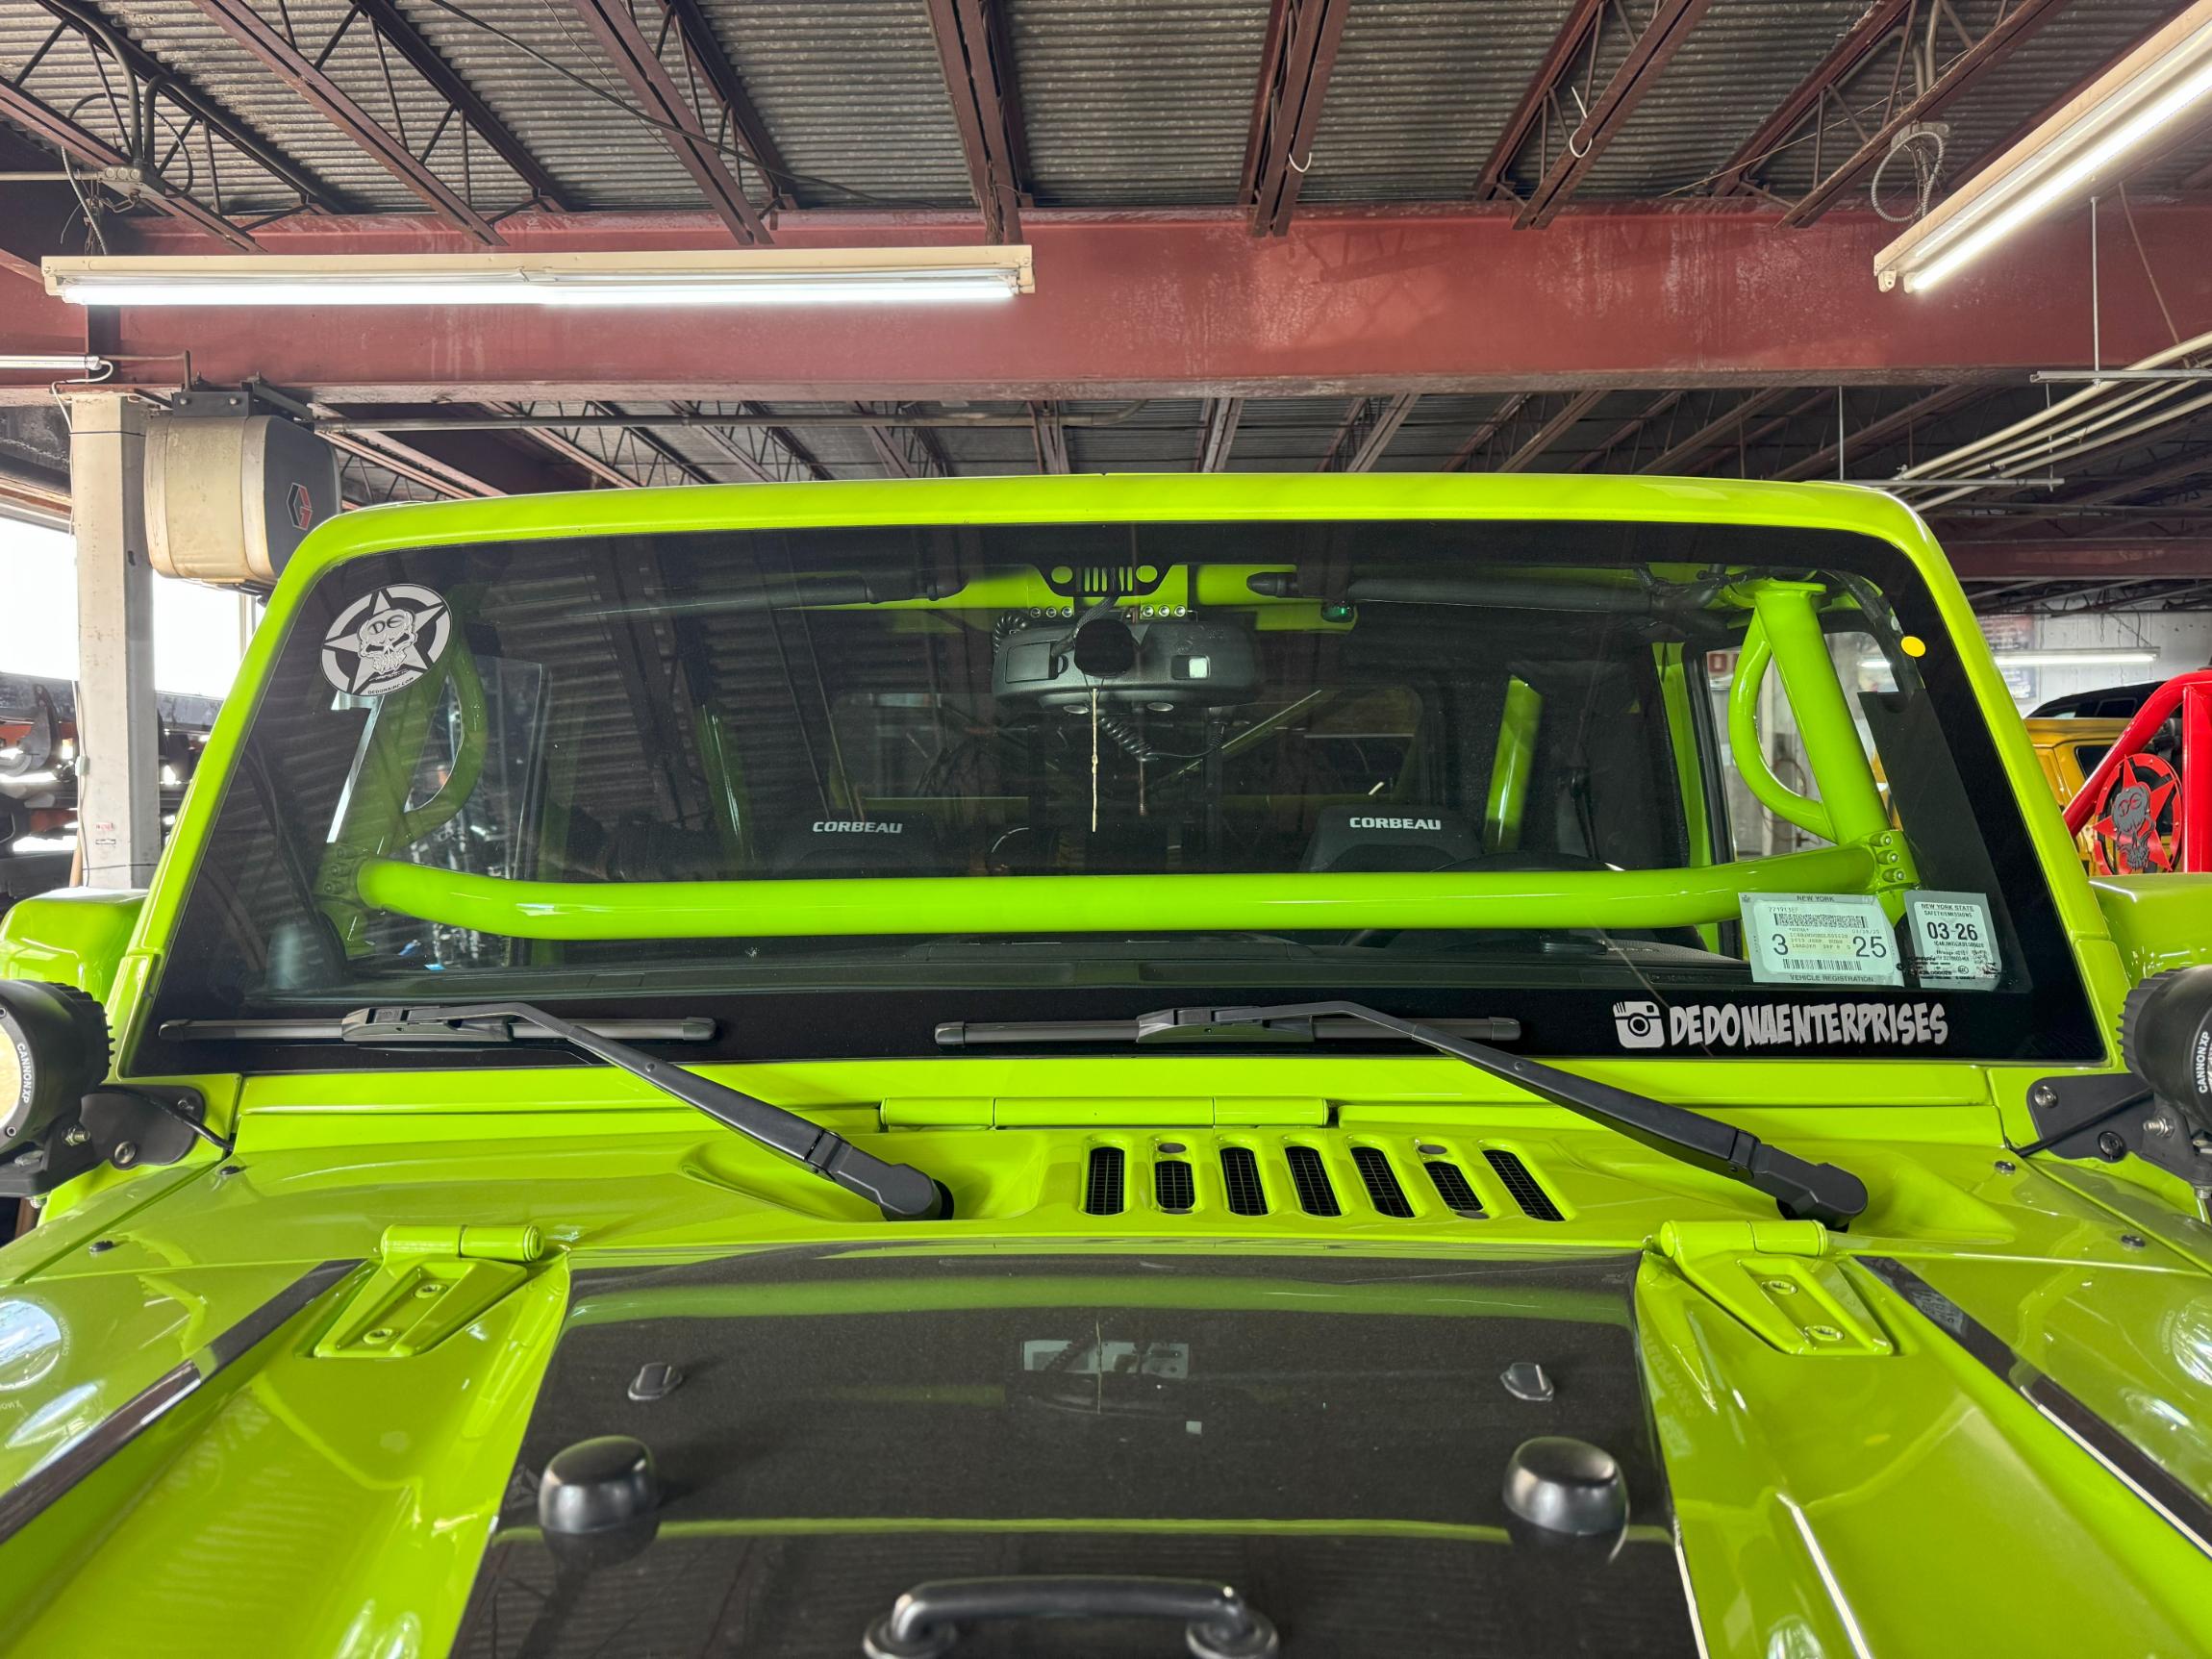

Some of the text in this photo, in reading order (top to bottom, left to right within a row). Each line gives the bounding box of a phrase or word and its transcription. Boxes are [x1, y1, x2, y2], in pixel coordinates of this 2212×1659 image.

[812, 820, 903, 834] CORBEAU
[1349, 817, 1442, 830] CORBEAU
[1926, 921, 1978, 942] 03-26
[1772, 934, 1789, 956] 3
[1852, 936, 1887, 958] 25
[1669, 1002, 1948, 1049] DEDONAENTERPRISES
